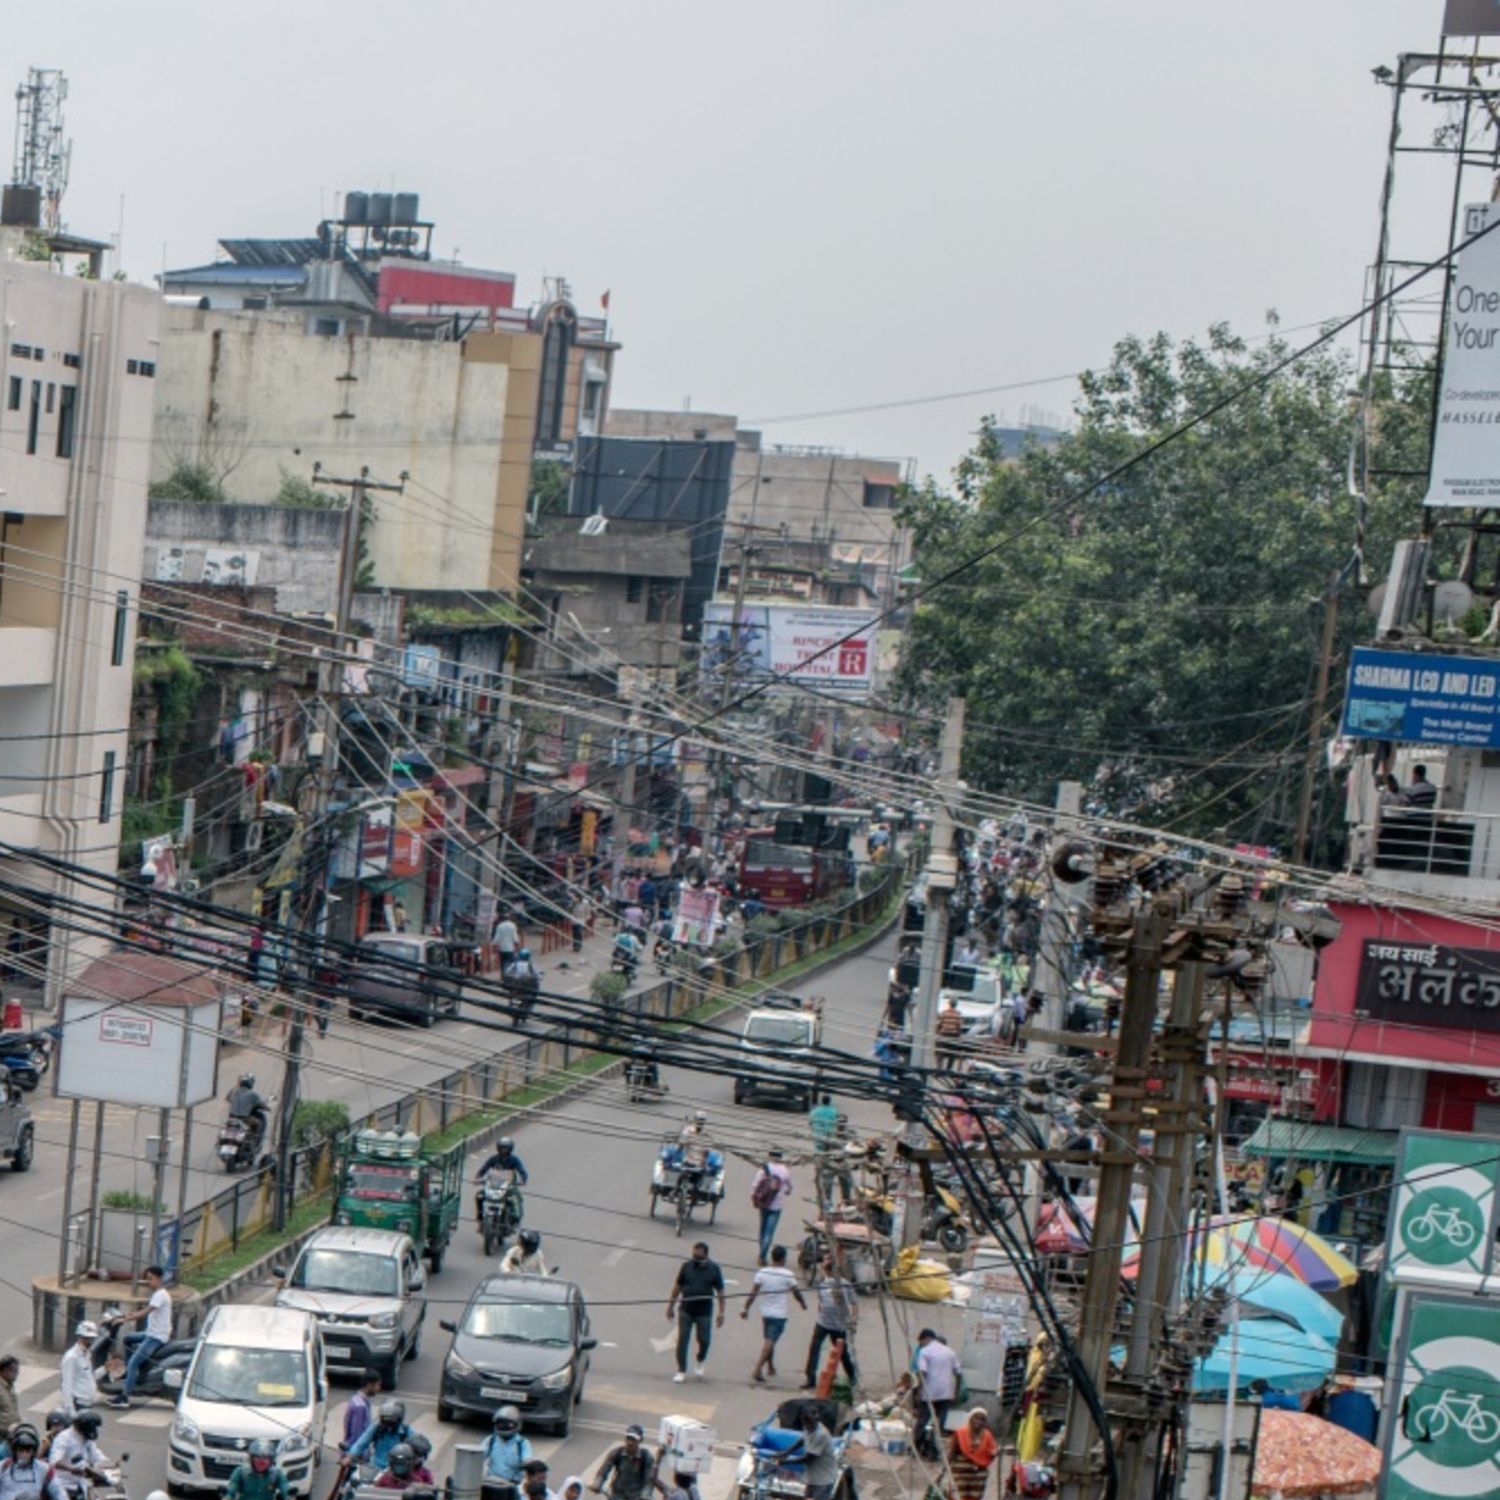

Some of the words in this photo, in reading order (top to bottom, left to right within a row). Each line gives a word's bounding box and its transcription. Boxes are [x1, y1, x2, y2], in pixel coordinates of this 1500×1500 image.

[1454, 323, 1500, 349] Your
[1354, 664, 1411, 690] SHARMA
[1441, 672, 1469, 695] AND
[1471, 675, 1496, 697] LED
